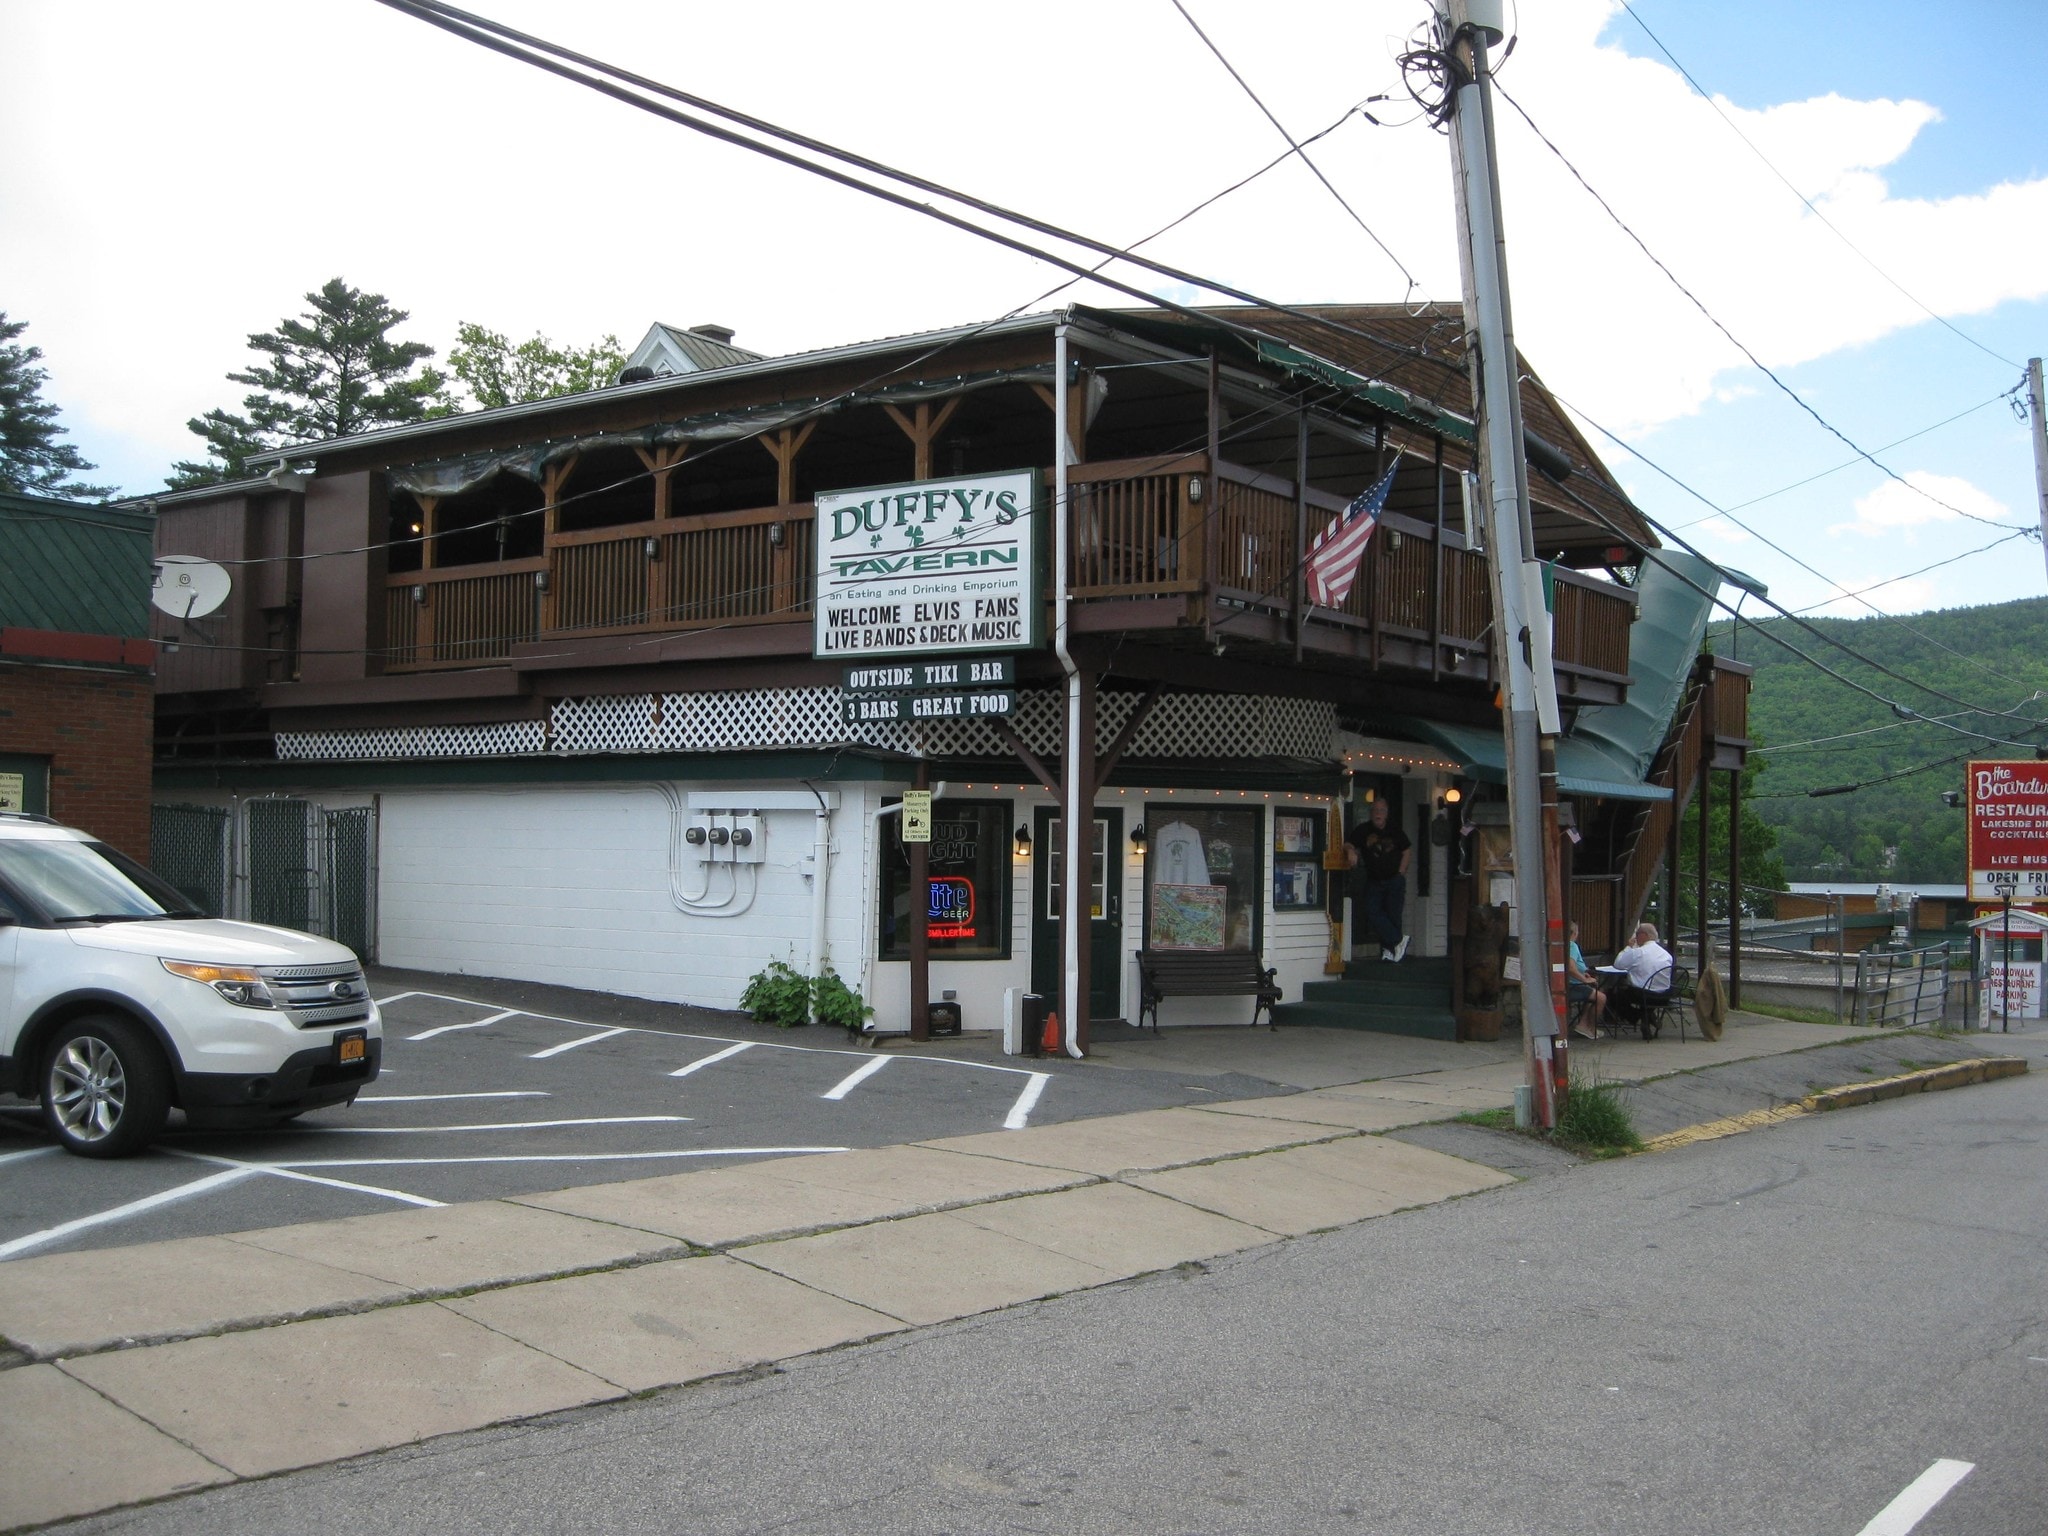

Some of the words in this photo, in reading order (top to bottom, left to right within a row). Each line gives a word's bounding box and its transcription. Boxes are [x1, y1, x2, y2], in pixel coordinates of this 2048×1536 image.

[830, 488, 1019, 542] DUFFY'S
[829, 547, 1018, 577] TAVERN
[829, 592, 842, 600] an
[847, 589, 882, 600] Eating
[888, 586, 907, 596] and
[912, 582, 957, 595] Drinking
[963, 578, 1018, 593] Emporium
[828, 605, 901, 628] WELCOME
[914, 601, 960, 622] ELVIS
[975, 597, 1019, 618] FANS
[825, 630, 859, 650] LIVE
[863, 626, 916, 648] BANDS
[920, 626, 928, 642] &
[930, 623, 968, 643] DECK
[971, 620, 1021, 641] MUSIC
[850, 668, 913, 688] OUTSIDE
[925, 665, 958, 684] TIKI
[971, 662, 1003, 681] BAR
[848, 703, 855, 720] 3
[860, 700, 898, 720] BARS
[913, 697, 963, 717] GREAT
[970, 694, 1009, 714] FOOD
[1992, 766, 2011, 781] the
[1975, 804, 2048, 816] RESTAUR
[932, 824, 968, 842] UD
[1981, 820, 2032, 828] LAKESIDE
[1991, 856, 2018, 864] LIVE
[1987, 872, 2018, 883] OPEN
[1994, 885, 2017, 896] ST
[942, 910, 969, 918] BEER
